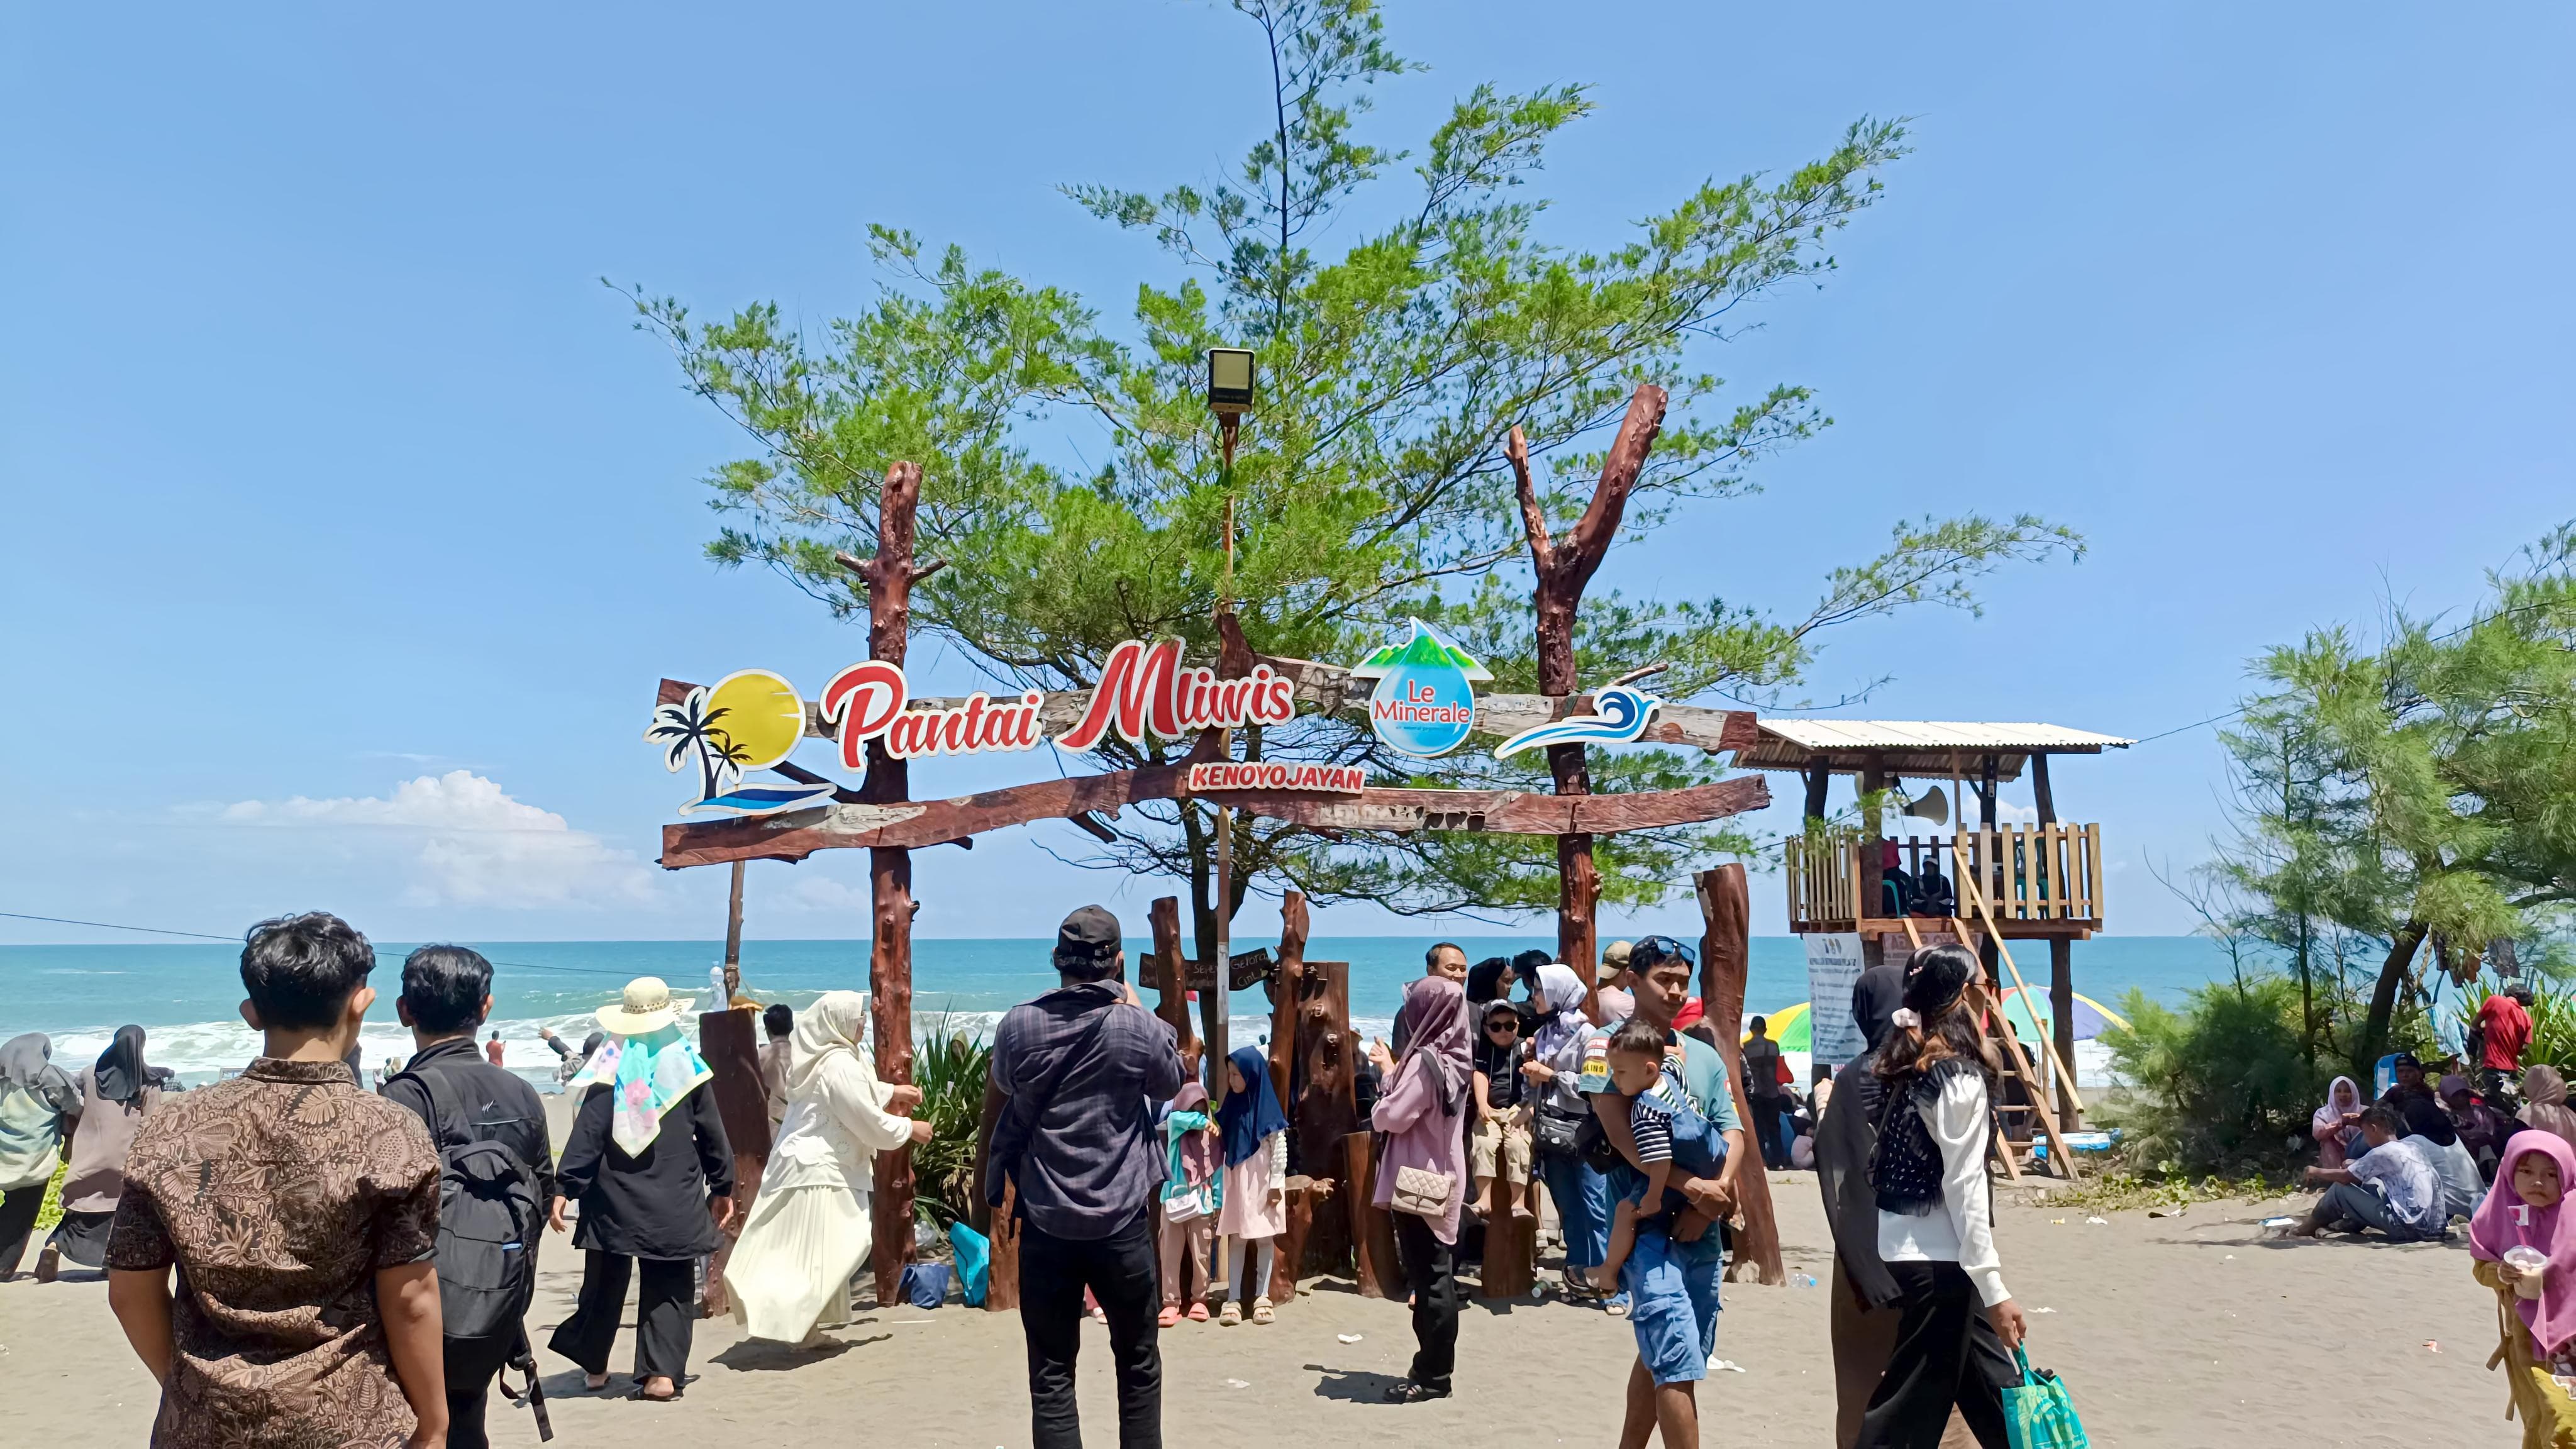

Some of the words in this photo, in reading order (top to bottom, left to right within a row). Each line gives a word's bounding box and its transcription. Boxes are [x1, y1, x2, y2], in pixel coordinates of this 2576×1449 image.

[1408, 679, 1435, 703] Le
[824, 665, 1041, 769] Pantai
[1374, 699, 1470, 723] Minerale
[1192, 765, 1364, 791] KENOYOJAYAN
